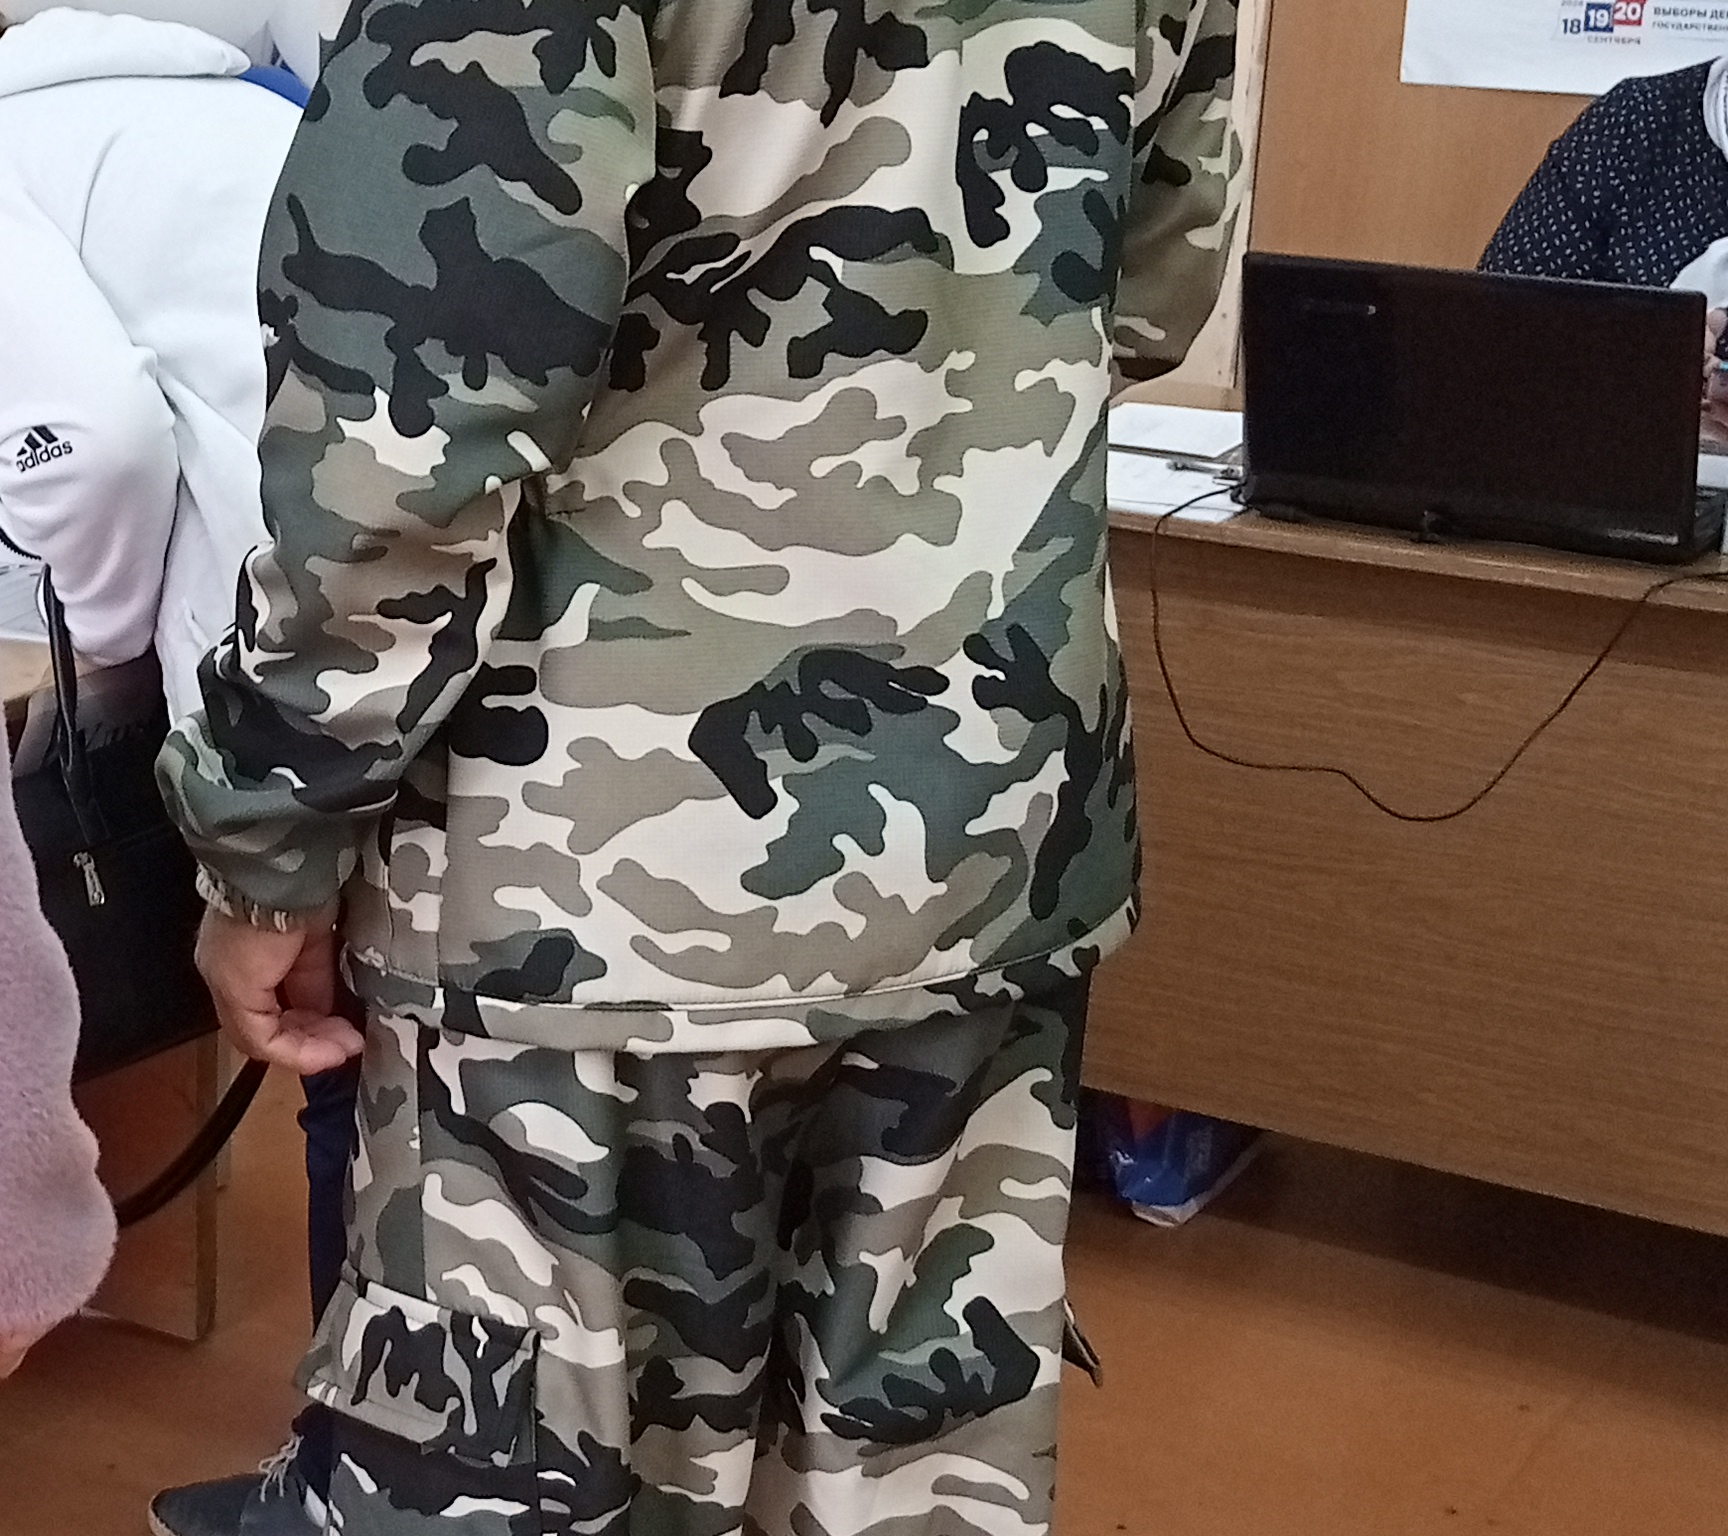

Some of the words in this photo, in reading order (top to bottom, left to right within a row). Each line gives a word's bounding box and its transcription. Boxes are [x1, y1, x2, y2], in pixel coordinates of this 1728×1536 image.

[1562, 18, 1582, 35] 18
[1587, 9, 1610, 29] 19
[1613, 1, 1642, 22] 20
[1653, 6, 1707, 18] ВЫБОРЫ
[15, 440, 73, 474] adidas
